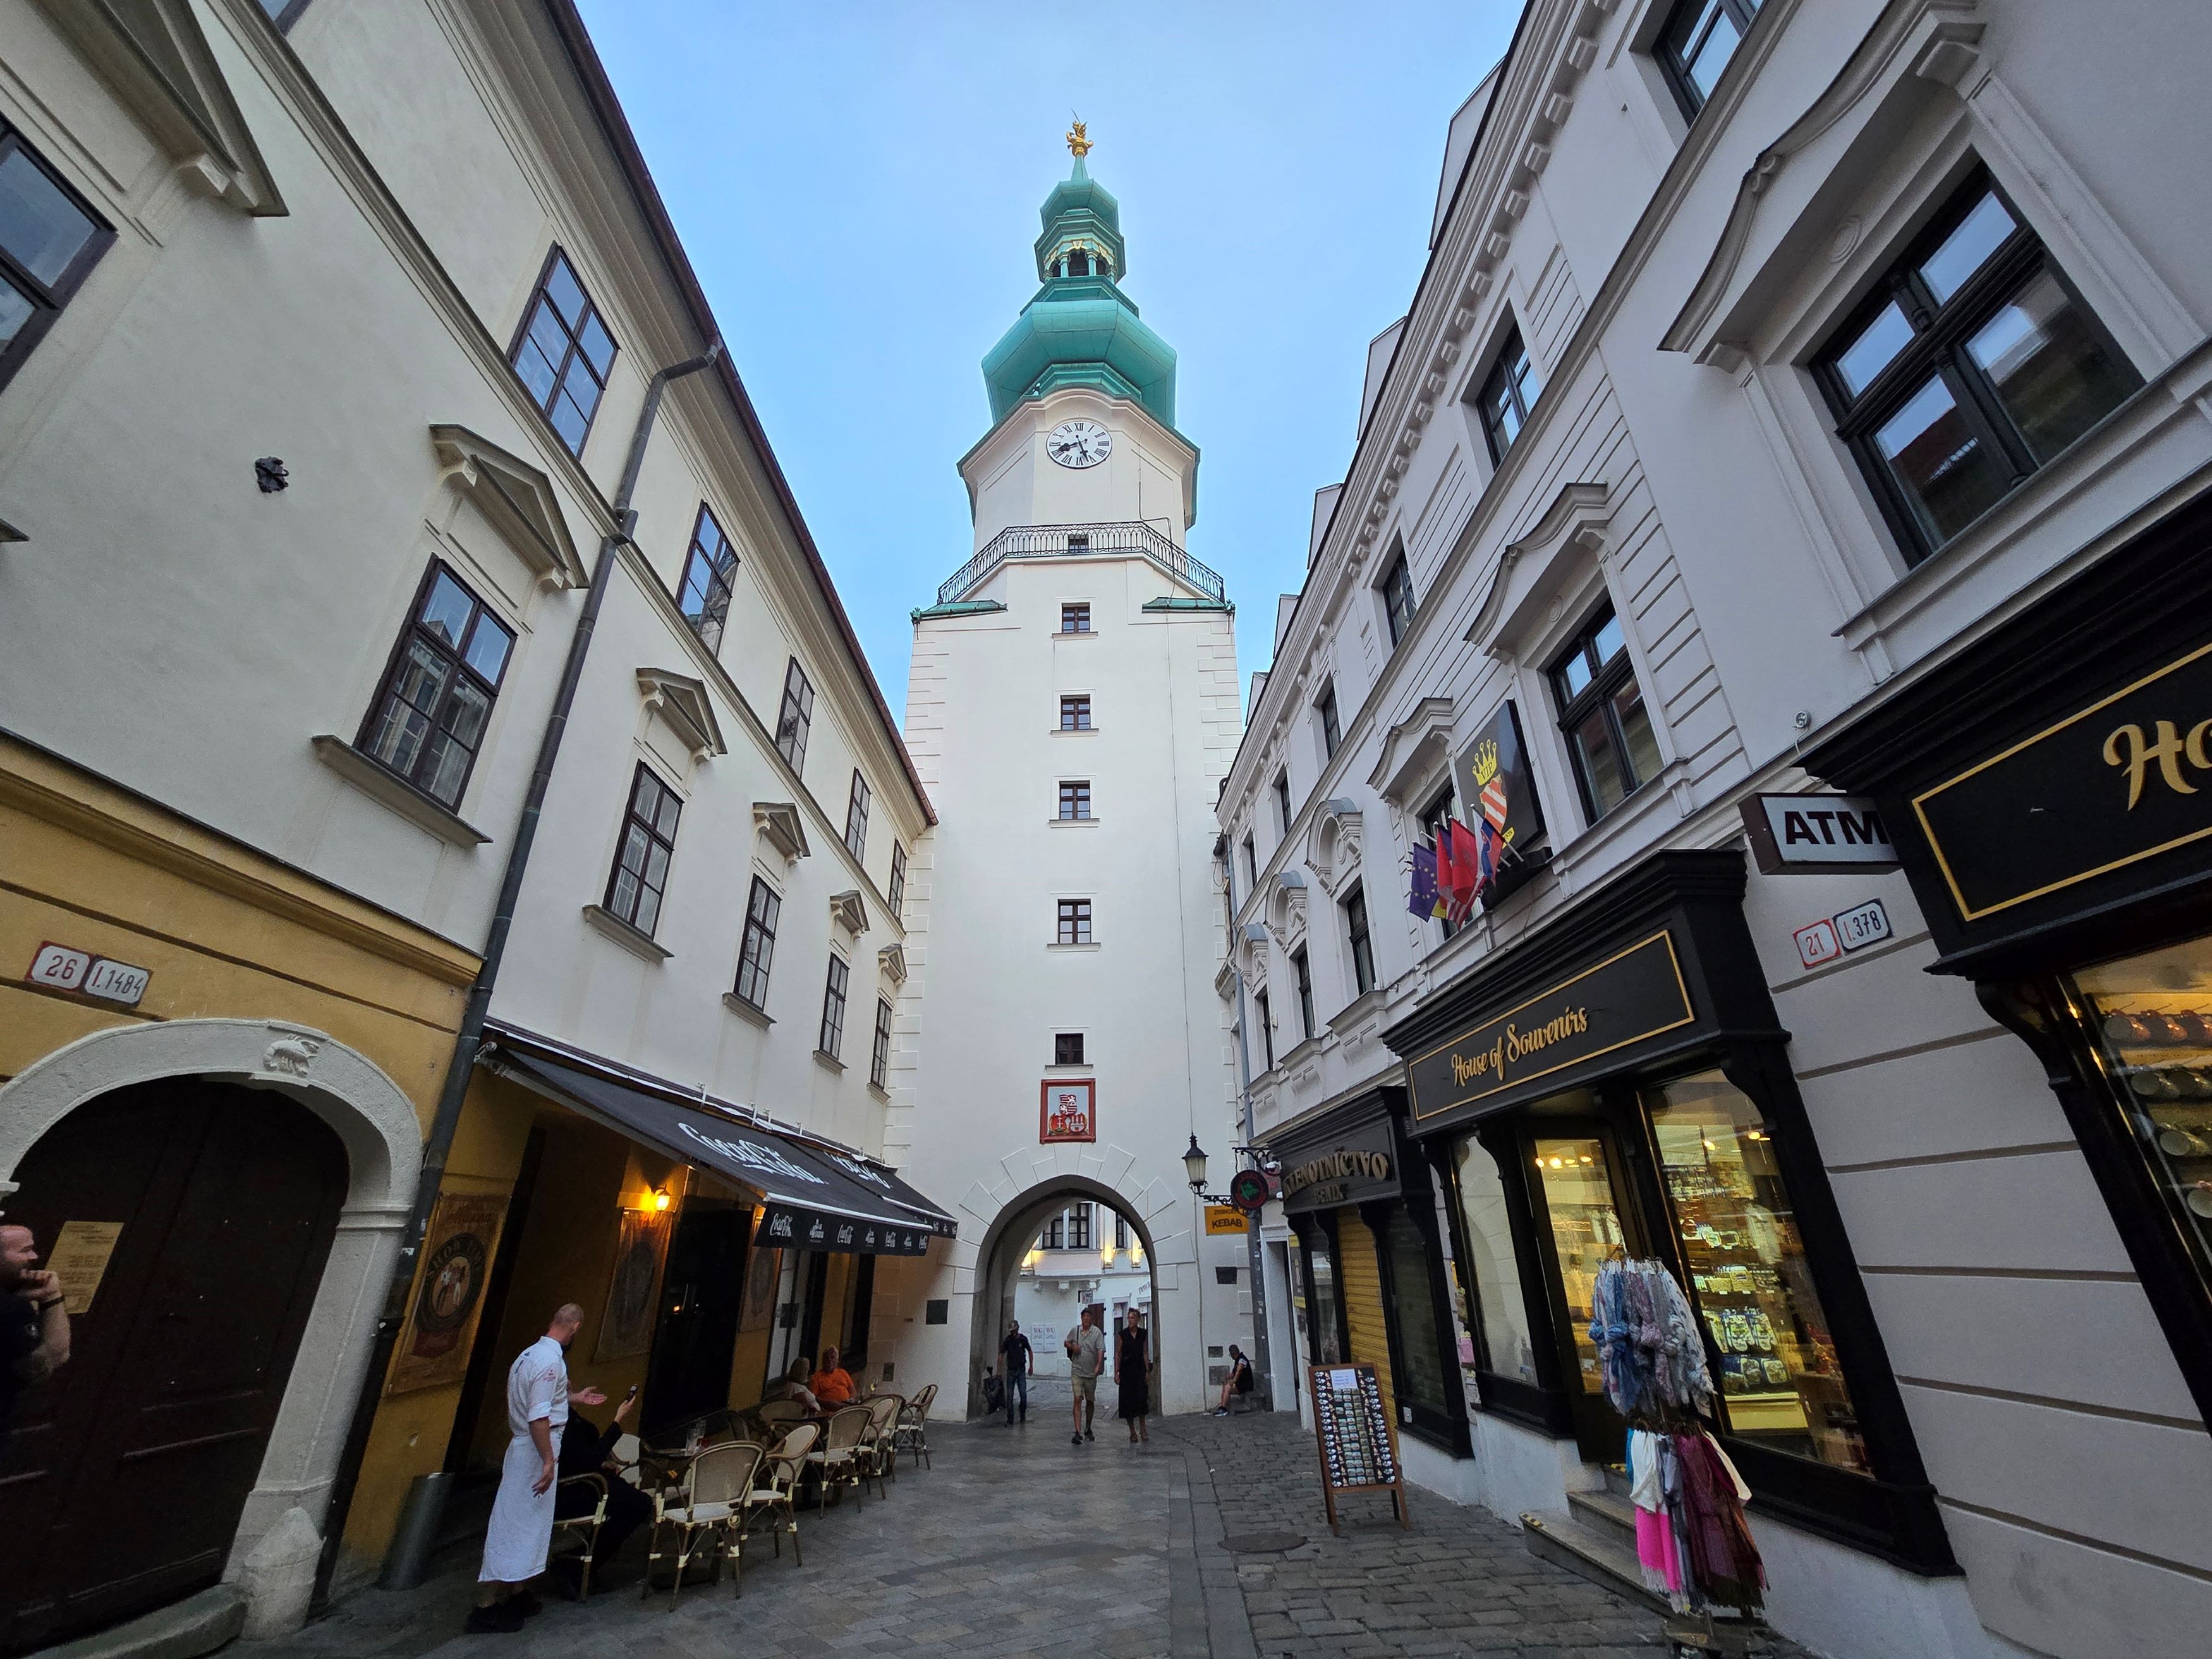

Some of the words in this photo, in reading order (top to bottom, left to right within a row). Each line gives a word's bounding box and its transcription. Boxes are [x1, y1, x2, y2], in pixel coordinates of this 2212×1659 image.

[1074, 423, 1084, 431] XII
[1481, 762, 1493, 780] VIP
[1784, 811, 1890, 844] ATM
[1806, 932, 1825, 956] 21
[45, 955, 77, 980] 26
[1452, 1054, 1488, 1086] House
[1490, 1036, 1504, 1081] of
[1507, 1006, 1588, 1062] Souvenirs
[1212, 1218, 1243, 1229] KEBAB
